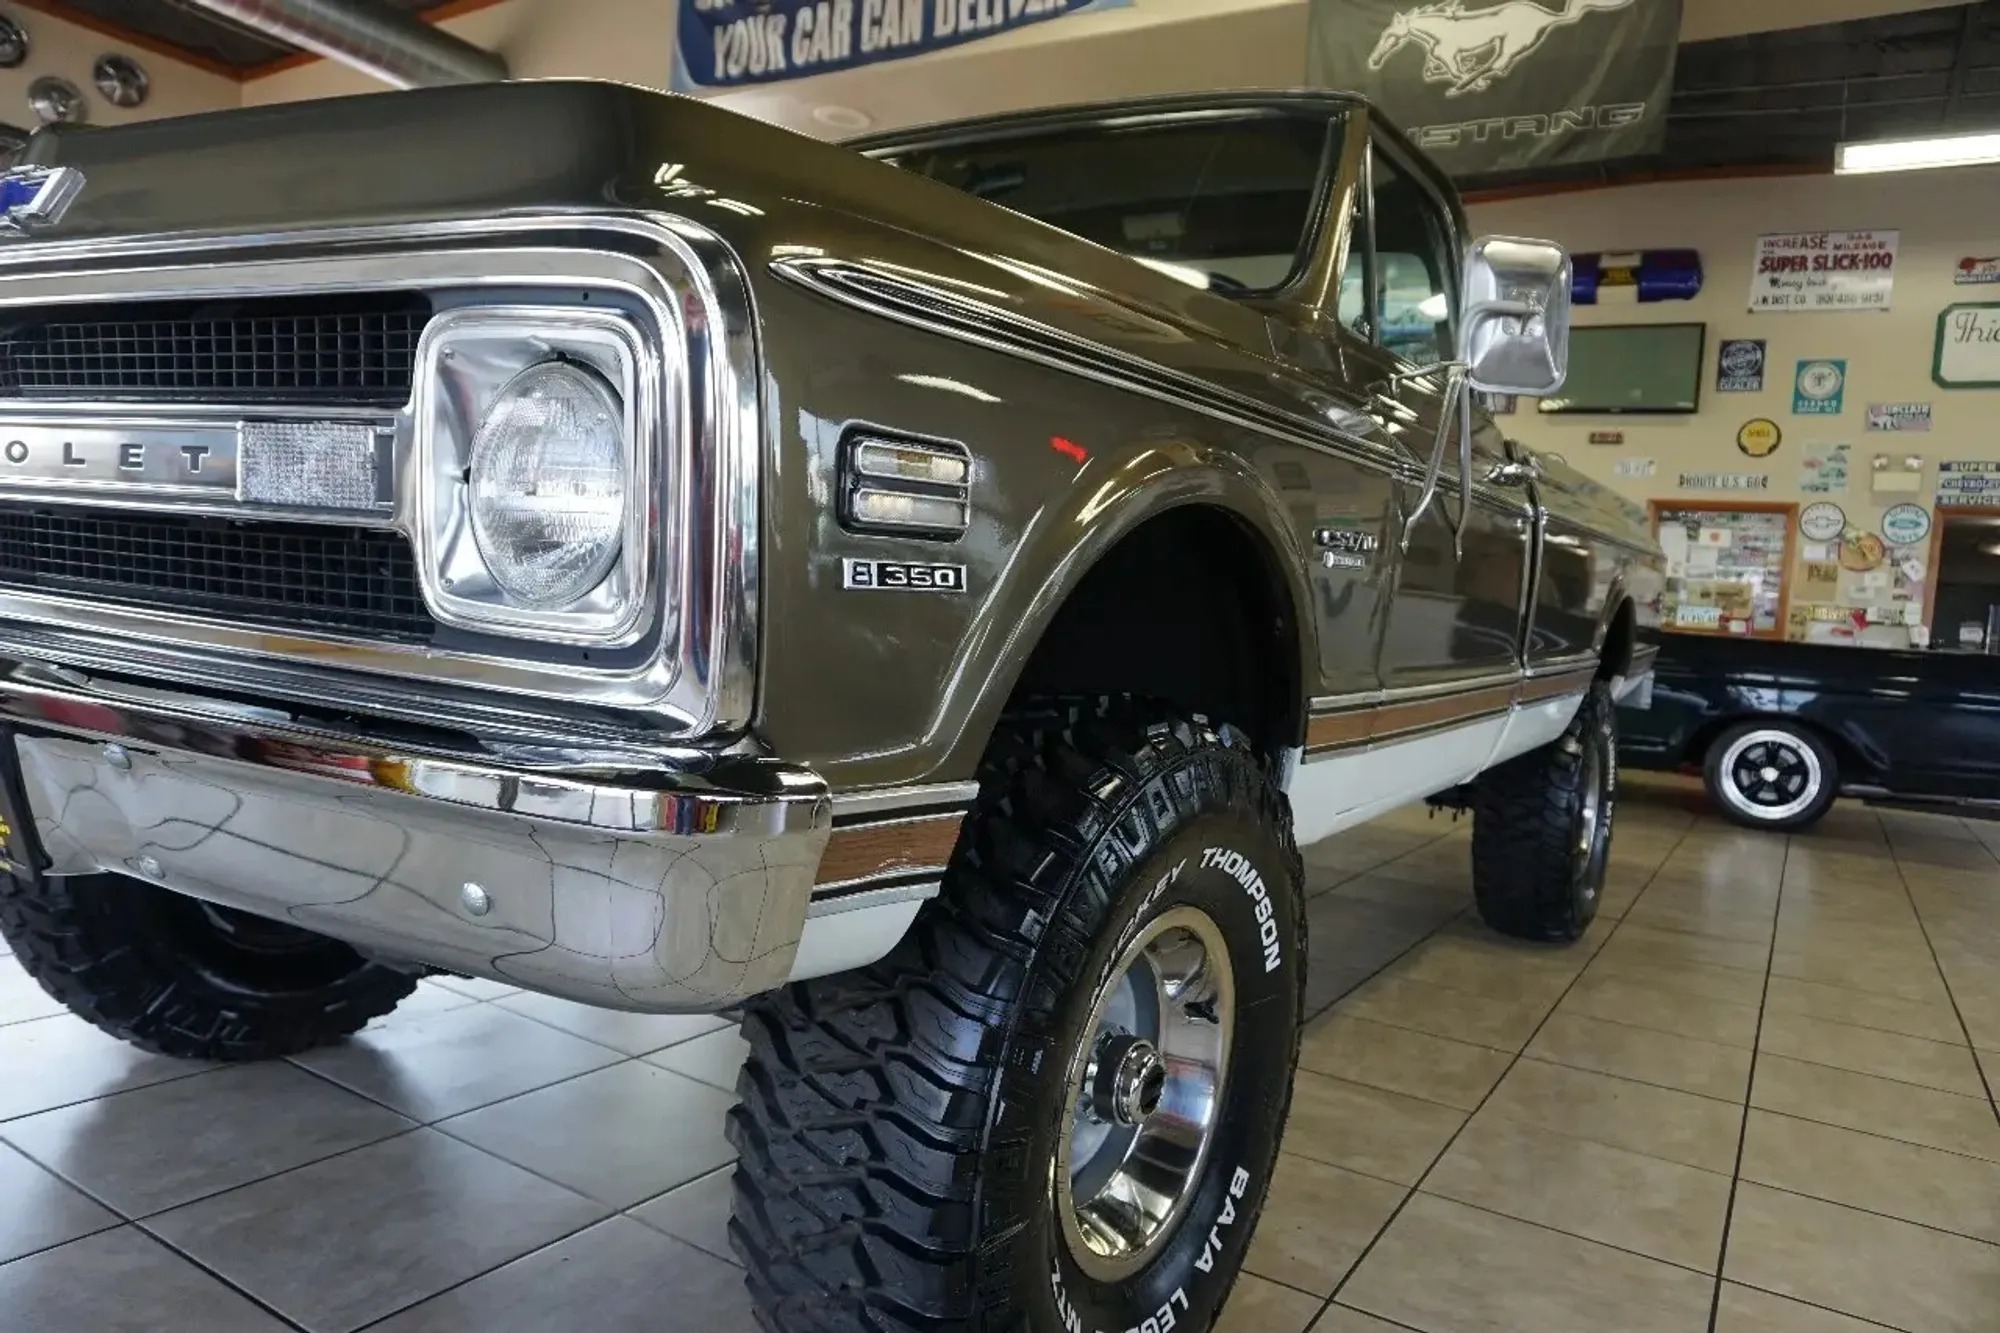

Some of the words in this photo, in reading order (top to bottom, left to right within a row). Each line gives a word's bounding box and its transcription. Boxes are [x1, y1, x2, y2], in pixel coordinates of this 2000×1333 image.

[714, 13, 787, 79] YOUR
[792, 0, 852, 66] CAR
[861, 0, 922, 51] CAN
[1405, 102, 1646, 148] STANG
[1758, 254, 1809, 274] SUPER
[1812, 251, 1893, 271] SLICK-100
[1763, 233, 1829, 249] INCREASE
[884, 565, 956, 587] 350
[1200, 846, 1282, 974] THOMPSON
[1194, 1165, 1250, 1274] BAJA
